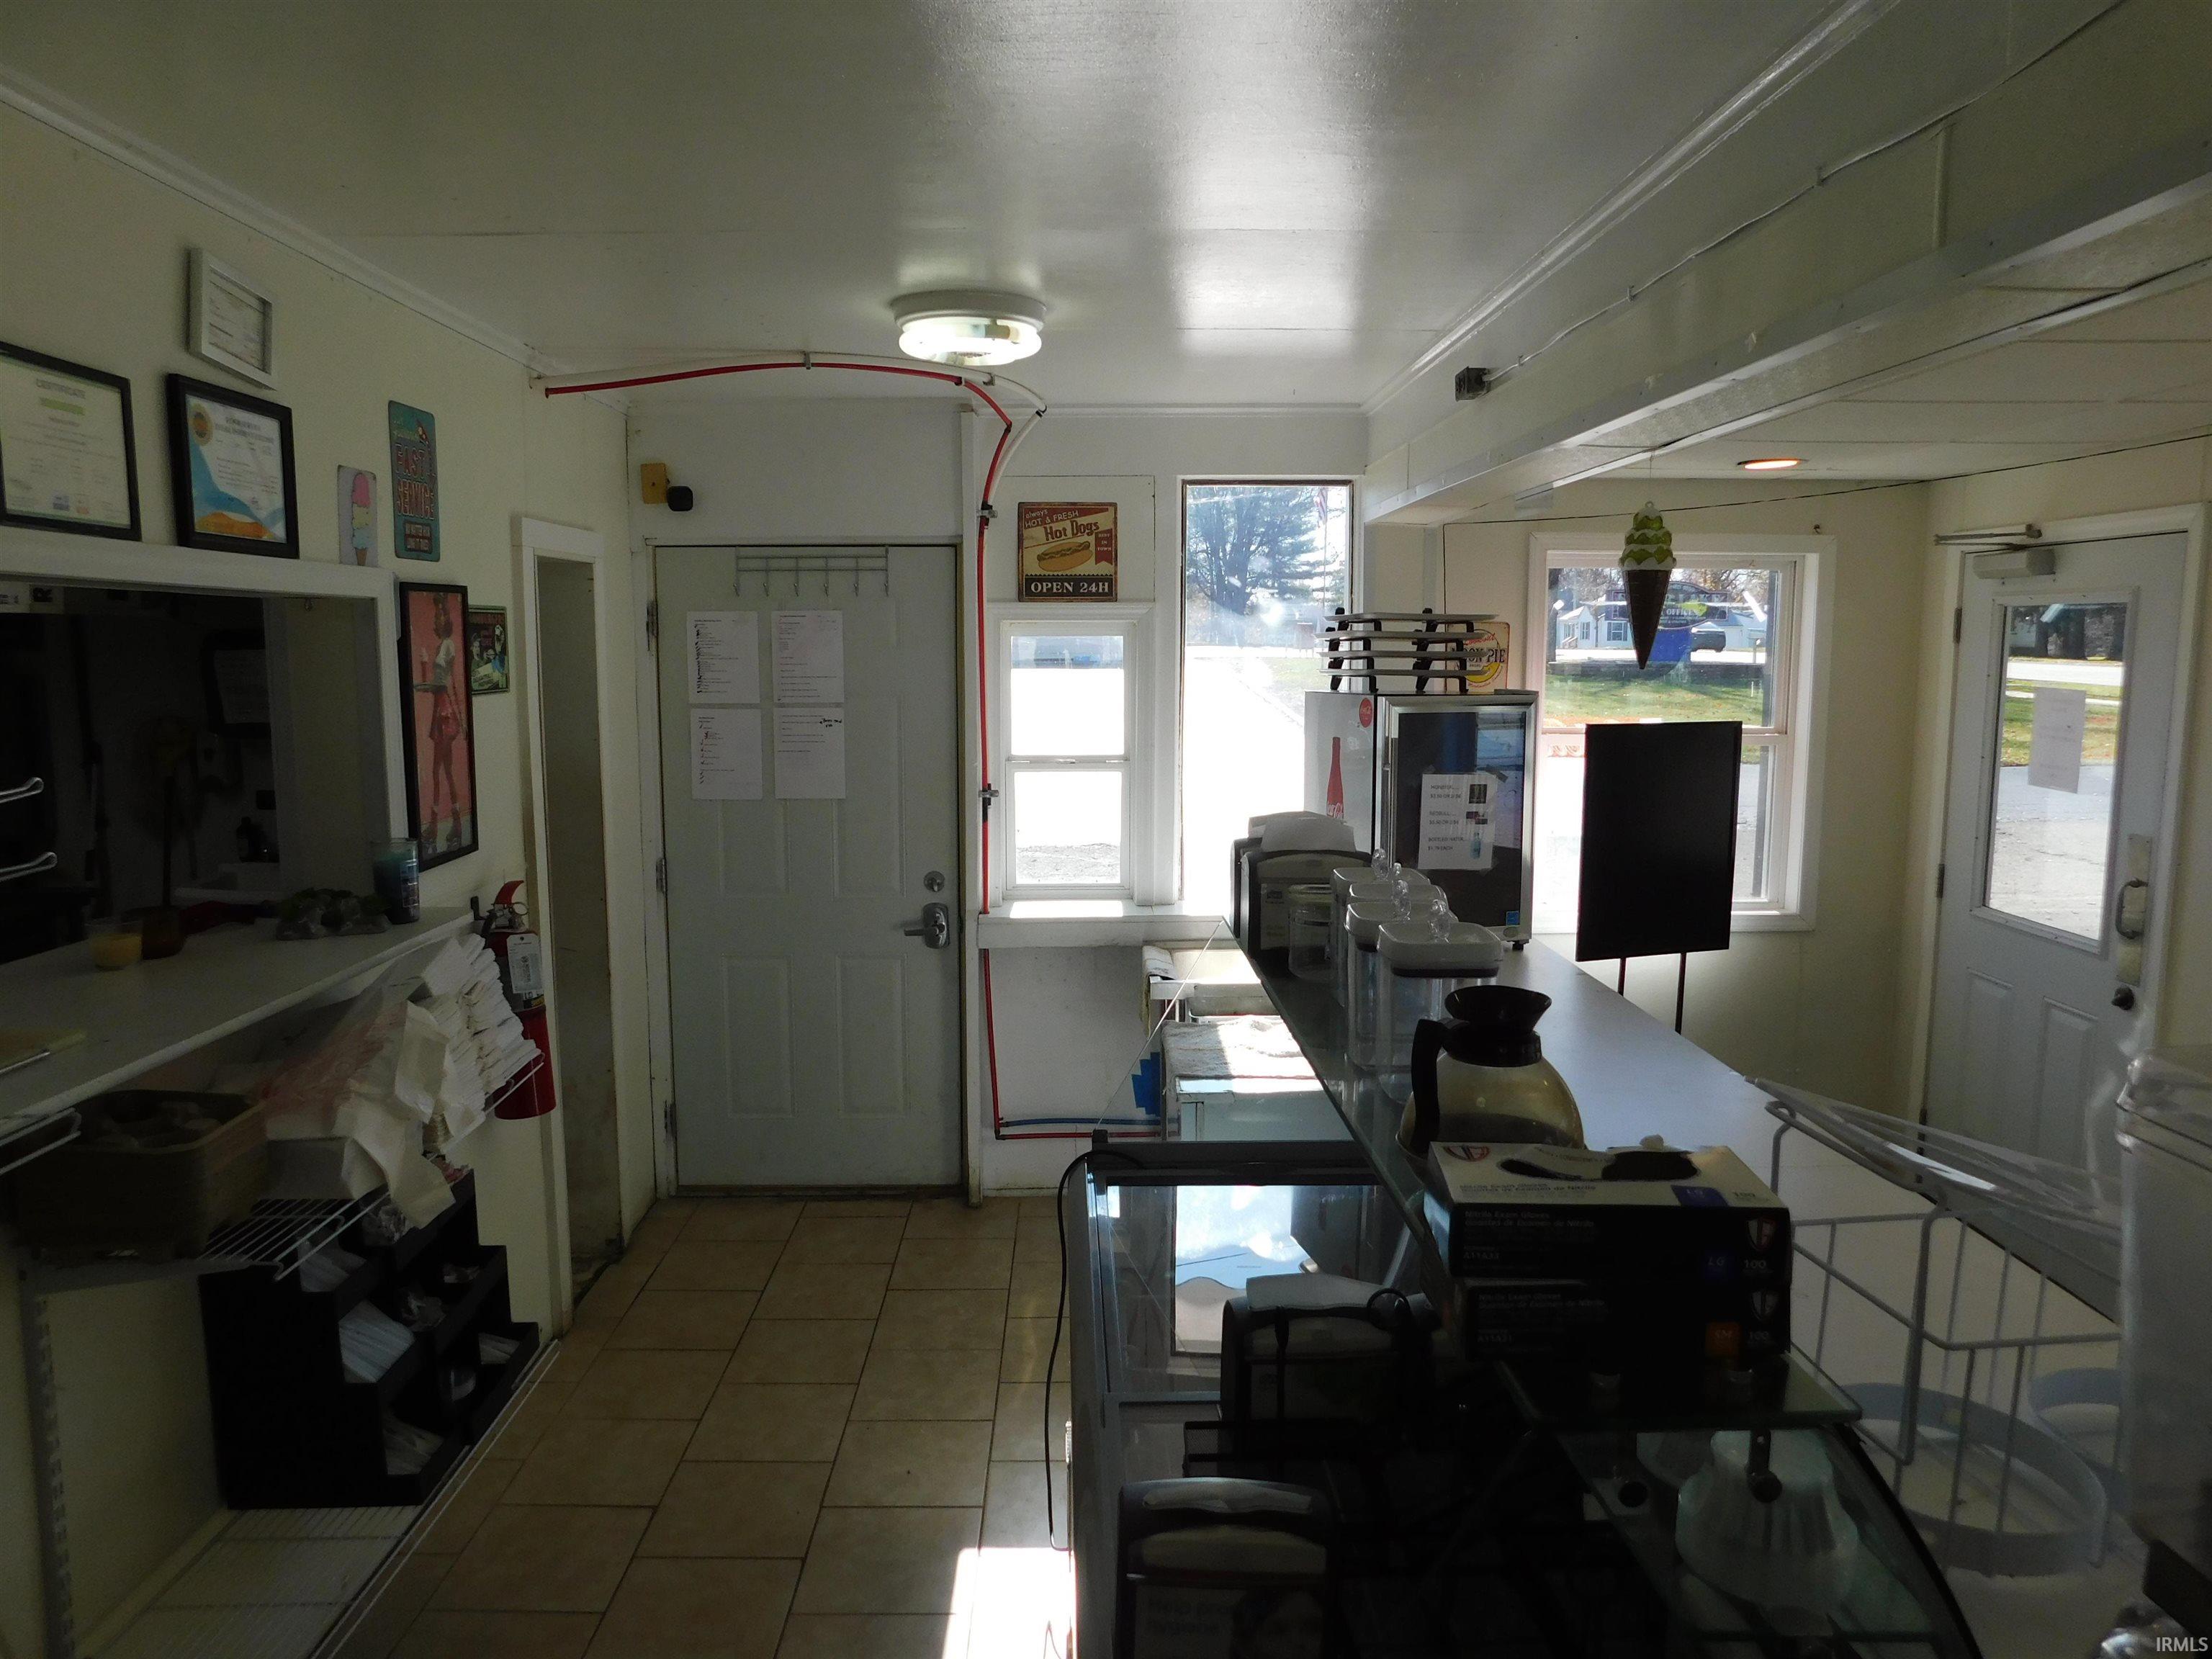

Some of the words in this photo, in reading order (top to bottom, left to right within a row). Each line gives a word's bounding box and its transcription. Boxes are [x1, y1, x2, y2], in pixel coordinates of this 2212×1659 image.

[395, 444, 425, 480] FAST
[397, 477, 434, 520] SERVICE
[1025, 508, 1048, 518] always
[1025, 518, 1042, 528] HOT
[1053, 510, 1079, 522] FRESH
[1043, 526, 1068, 541] Hot
[1069, 519, 1100, 537] Dogs
[1030, 582, 1074, 593] OPEN
[1080, 582, 1109, 593] 24H
[1486, 649, 1505, 662] PIE
[1707, 1256, 1725, 1266] LG
[1743, 1259, 1767, 1269] 100
